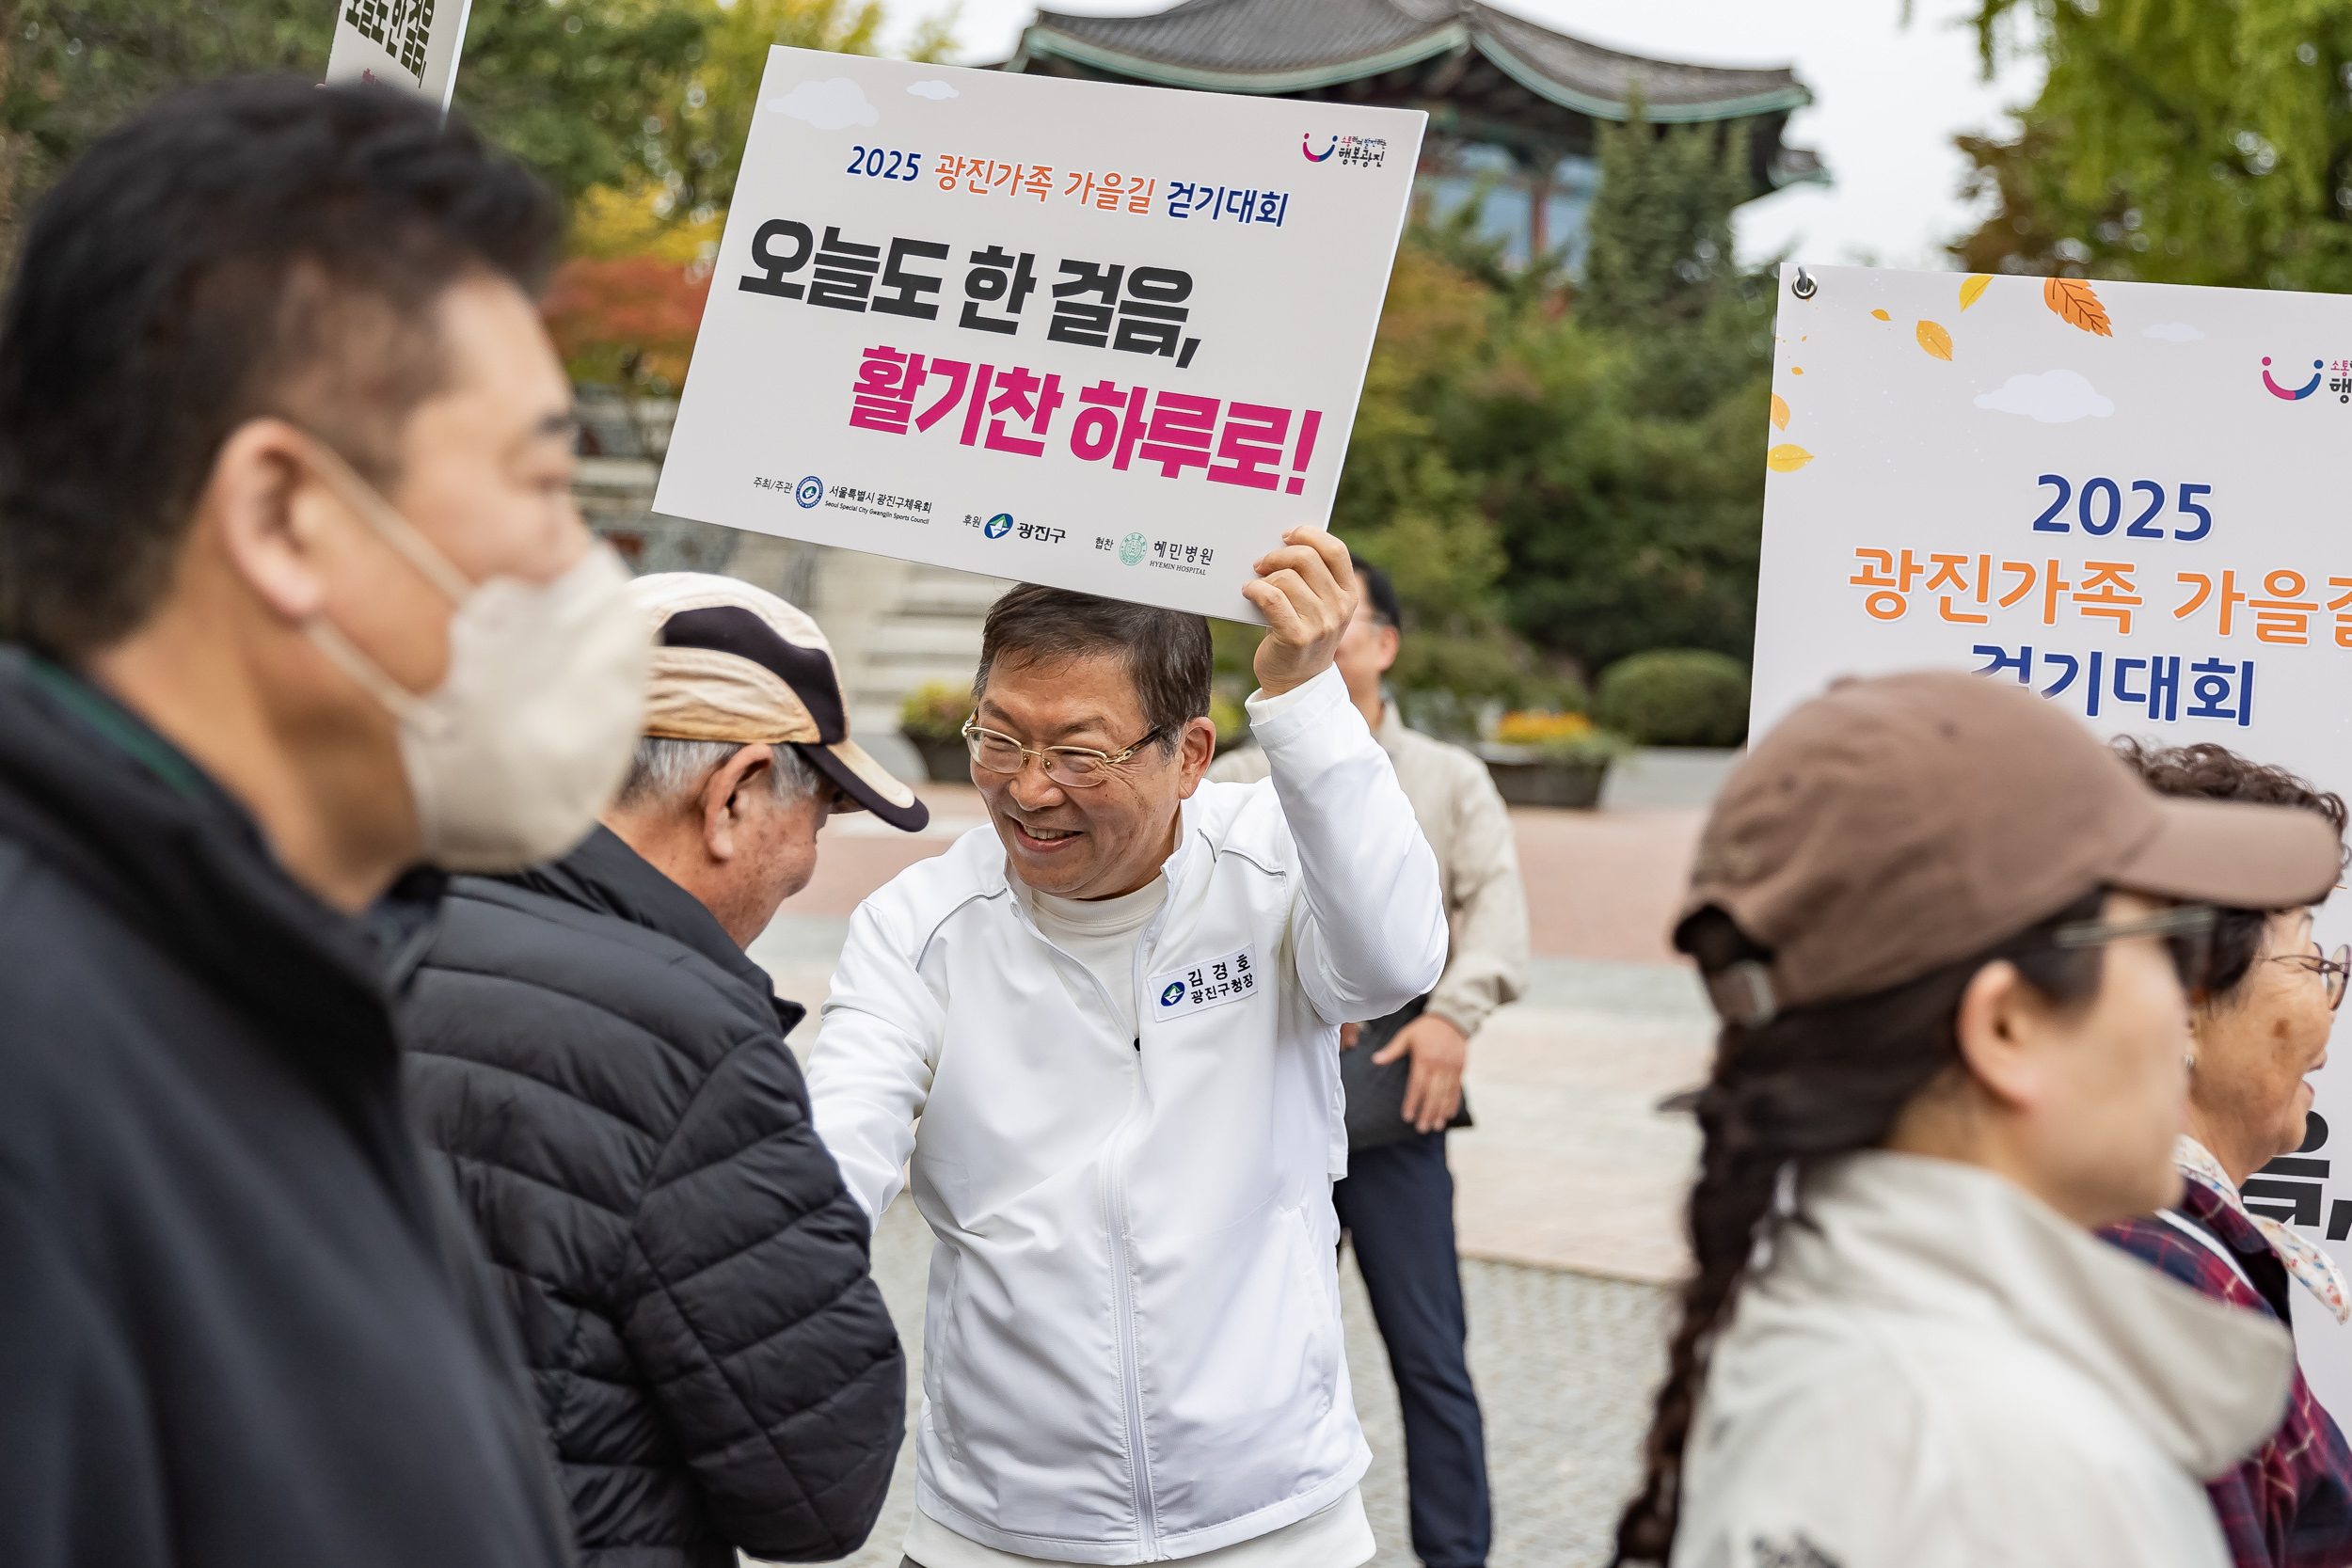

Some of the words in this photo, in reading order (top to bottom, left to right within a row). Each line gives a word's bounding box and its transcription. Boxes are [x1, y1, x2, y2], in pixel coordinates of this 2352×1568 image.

[1339, 147, 1385, 167] 행복광진
[847, 146, 921, 182] 2025
[935, 155, 1053, 202] 광진가족
[1065, 171, 1155, 214] 가을길
[1167, 182, 1288, 227] 걷기대회
[739, 218, 949, 321] 오늘도
[959, 245, 1037, 336] 한
[1047, 259, 1200, 369] 걸음,
[2330, 360, 2352, 377] 소통
[850, 345, 1064, 458] 활기찬
[1071, 380, 1323, 496] 하루로!
[753, 476, 793, 494] 주최/주관
[829, 485, 875, 503] 서울특별시
[877, 494, 932, 514] 광진구체육회
[2033, 474, 2214, 542] 2025
[839, 502, 858, 511] Special
[858, 506, 868, 515] City
[910, 515, 930, 524] Council
[962, 515, 981, 528] 후원
[1017, 522, 1066, 544] 광진구
[1095, 537, 1114, 551] 협찬
[1154, 541, 1214, 565] 혜민병원
[1150, 561, 1175, 570] HYEMIN
[1176, 565, 1206, 576] HOSPITAL
[1850, 547, 2143, 634] 광진가족
[1187, 954, 1250, 988] 김경호
[1191, 973, 1253, 1004] 광진구청장
